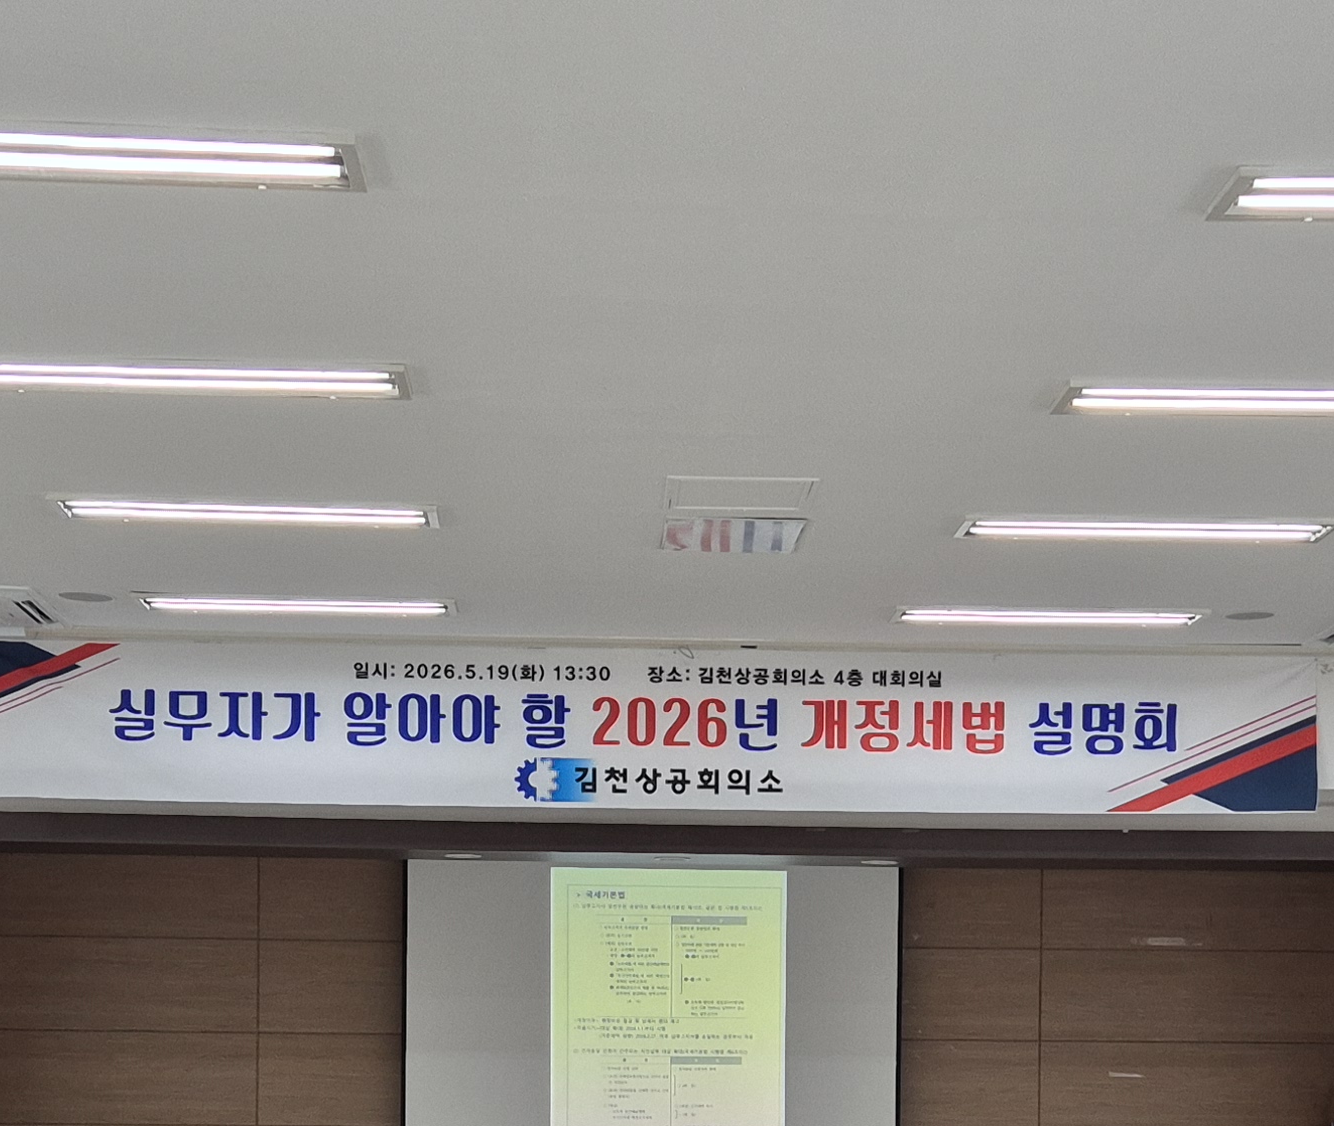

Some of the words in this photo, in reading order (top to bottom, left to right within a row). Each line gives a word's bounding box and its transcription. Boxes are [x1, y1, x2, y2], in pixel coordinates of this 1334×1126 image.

[353, 662, 396, 680] 일시:
[403, 663, 545, 682] 2026.5.19(화)
[553, 665, 611, 681] 13:30
[647, 666, 691, 683] 장소:
[698, 667, 825, 686] 김천상공회의소
[833, 669, 864, 687] 4층
[872, 670, 943, 687] 대회의실
[108, 688, 321, 742] 실무자가
[343, 692, 501, 746] 알아야
[521, 693, 571, 748] 할
[591, 695, 779, 752] 2026년
[800, 698, 1006, 755] 개정세법
[1028, 700, 1178, 756] 설명회
[574, 766, 784, 796] 김천상공회의소
